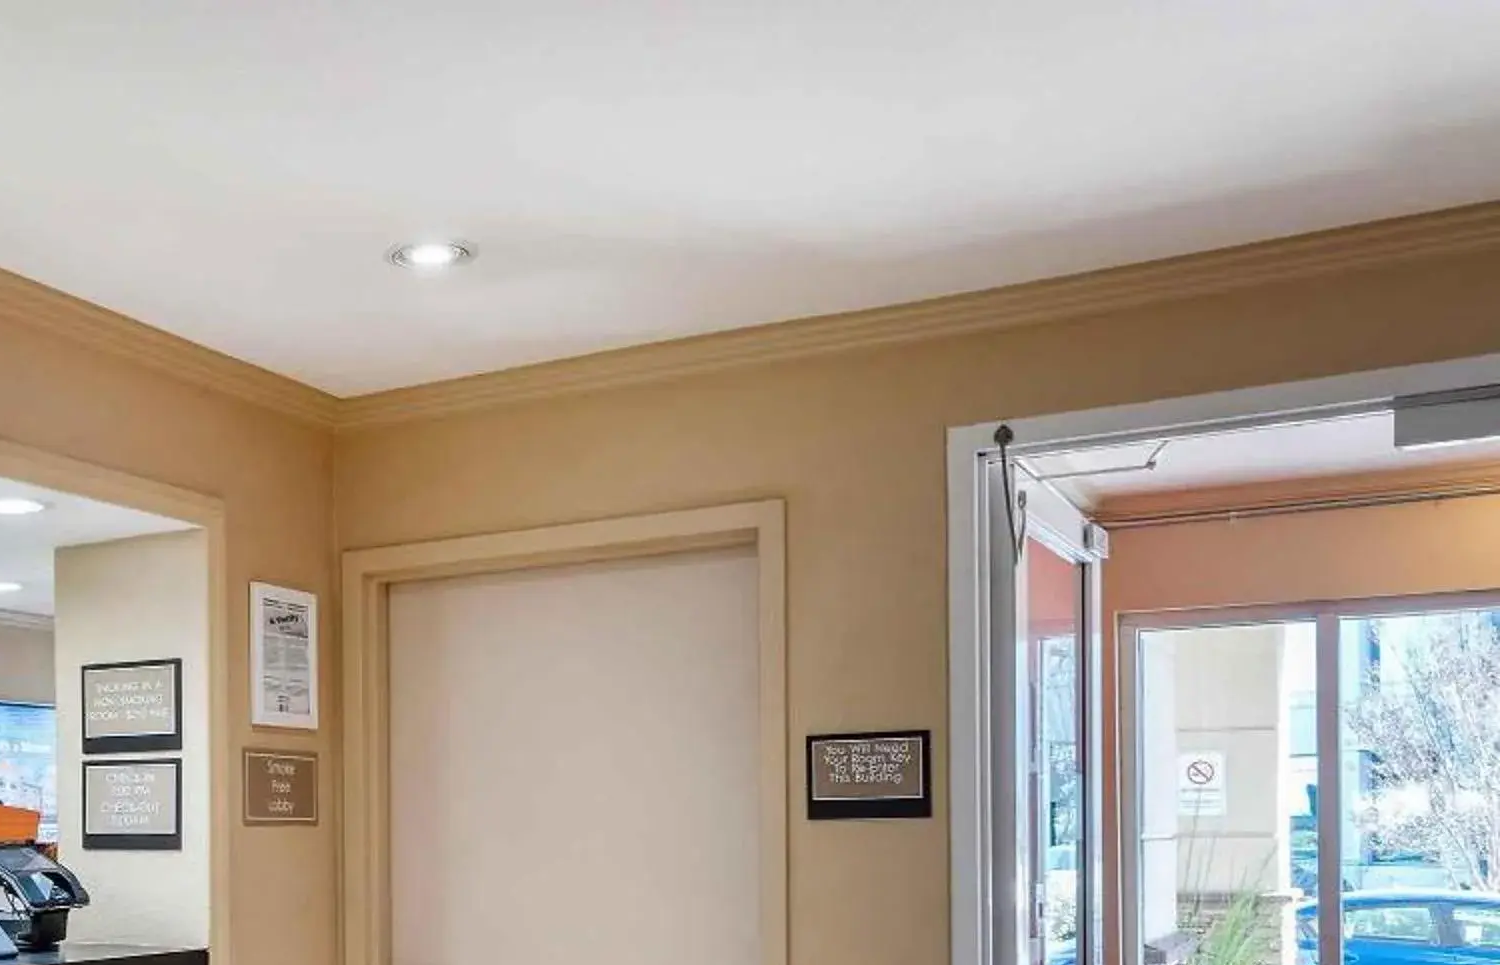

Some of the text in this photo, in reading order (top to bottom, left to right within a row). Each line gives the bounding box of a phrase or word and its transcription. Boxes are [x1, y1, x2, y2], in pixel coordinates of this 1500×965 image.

[825, 742, 909, 755] You Will Need
[823, 753, 911, 765] Your Room Key
[833, 763, 847, 774] To
[829, 773, 851, 783] This
